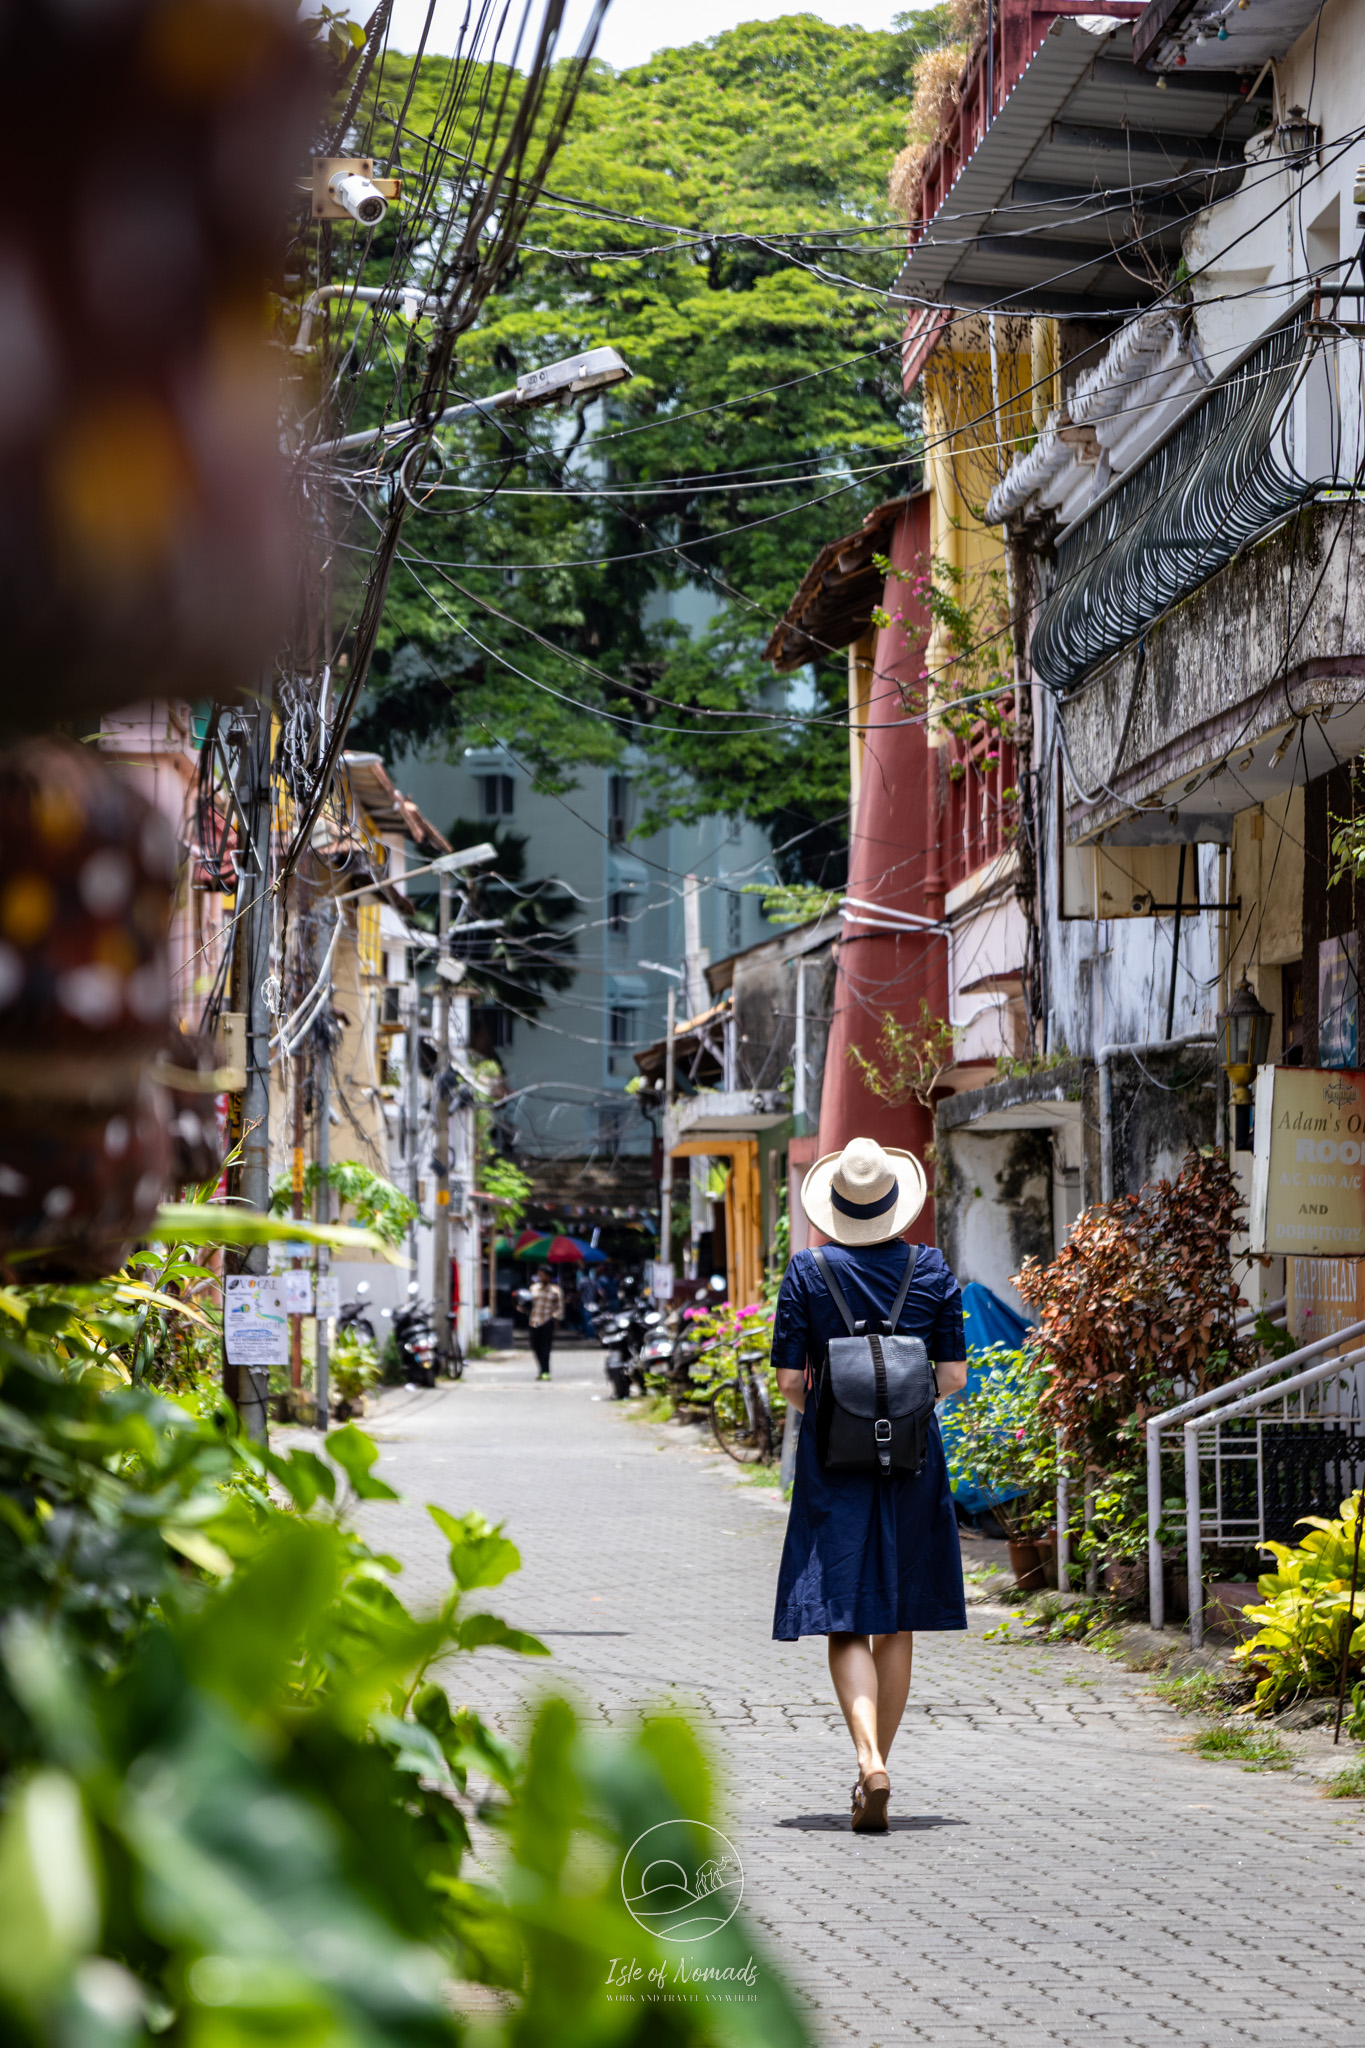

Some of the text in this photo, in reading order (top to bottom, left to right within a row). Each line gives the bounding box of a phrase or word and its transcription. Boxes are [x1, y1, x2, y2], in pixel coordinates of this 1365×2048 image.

[1278, 1110, 1365, 1134] Adam's O
[1308, 1173, 1336, 1188] NON
[1339, 1175, 1361, 1190] A/C
[1298, 1203, 1329, 1216] AND
[1276, 1224, 1361, 1242] DORMITORY
[1294, 1259, 1357, 1303] KAPITHAN
